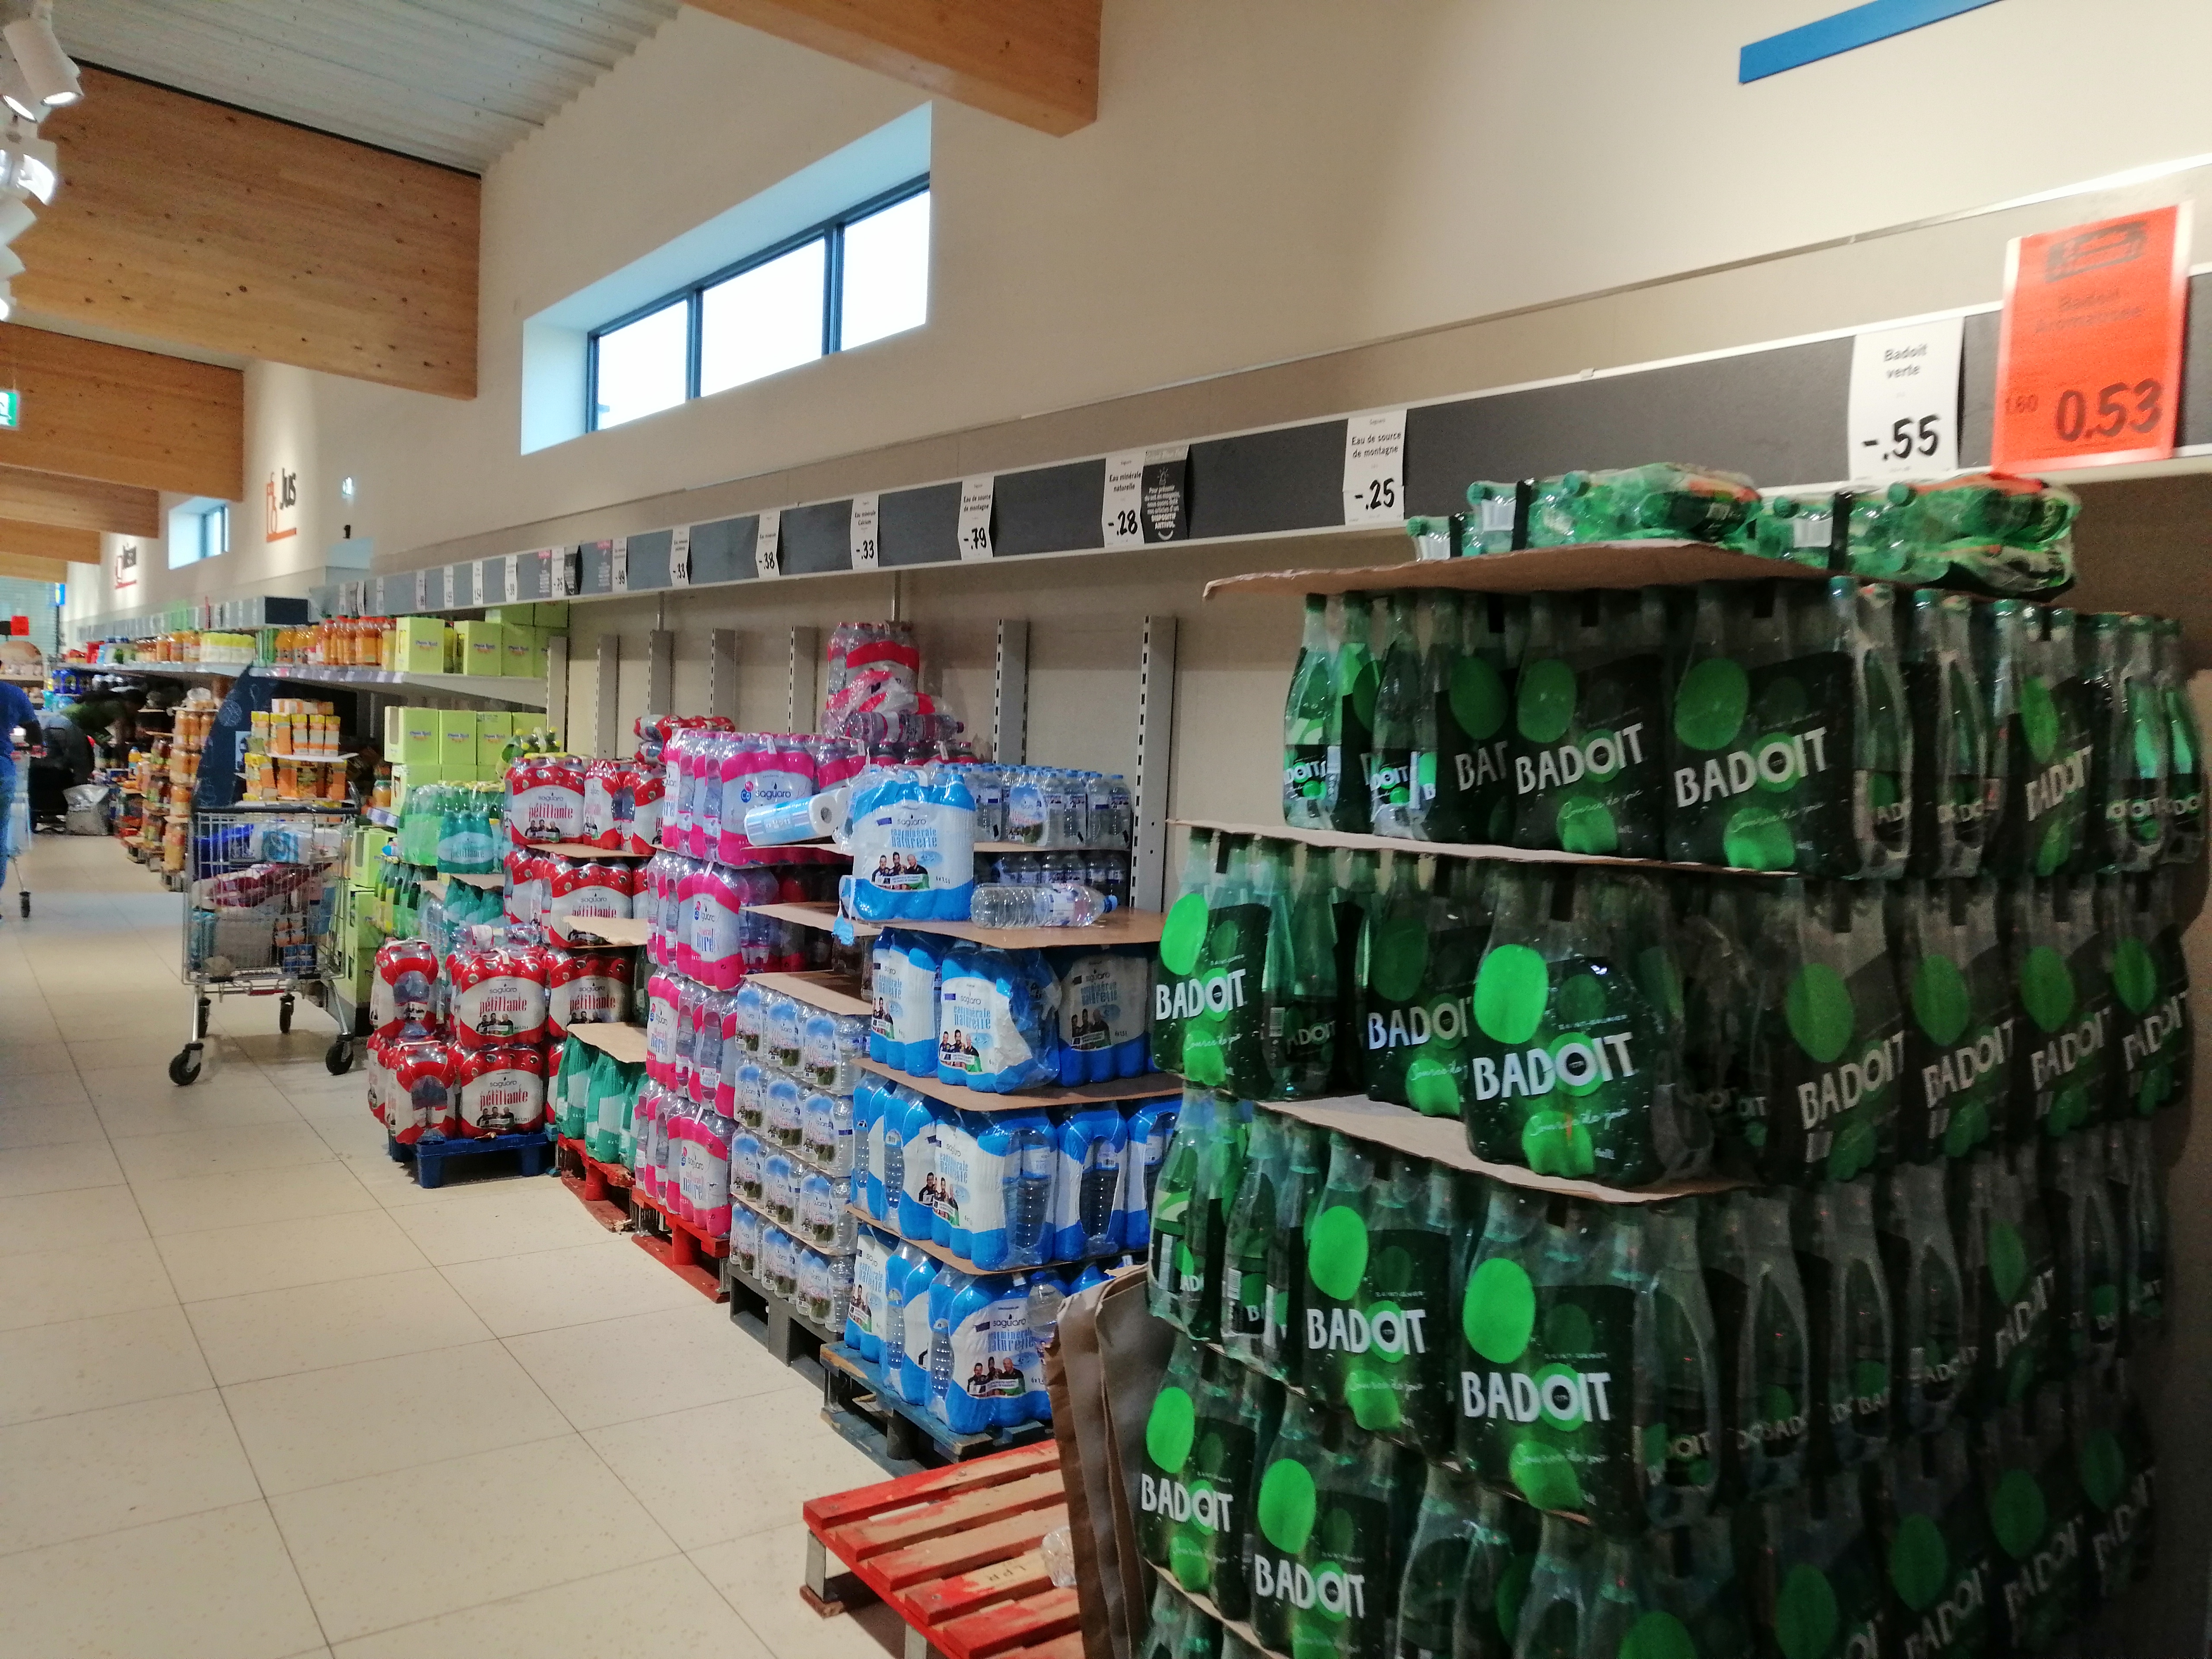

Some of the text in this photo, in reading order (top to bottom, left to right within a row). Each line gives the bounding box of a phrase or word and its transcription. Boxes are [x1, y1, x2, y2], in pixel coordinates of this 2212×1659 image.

[1884, 343, 1927, 362] Badoit
[1887, 365, 1920, 379] verte
[2055, 378, 2163, 442] 0.53
[1351, 432, 1402, 446] Eau de source
[1353, 446, 1398, 458] de montagne
[1109, 471, 1142, 483] Eau minérale
[1113, 483, 1135, 493] naturelle
[280, 467, 296, 511] Jus
[1515, 722, 1644, 795] BADOIT
[1673, 726, 1828, 809] BADOIT
[755, 790, 791, 800] saguaro
[529, 802, 573, 822] pétillante
[891, 830, 938, 849] naturelle
[479, 994, 528, 1017] pétillante
[569, 992, 616, 1014] pétillante
[1155, 969, 1247, 1021] BADOIT
[1472, 1032, 1636, 1101] BADOIT
[489, 1080, 517, 1088] saguaro
[1798, 1030, 1904, 1130] BADOIT
[479, 1087, 528, 1111] pétillante
[993, 1318, 1027, 1328] saguaro
[1306, 1308, 1427, 1355] BADOIT
[1460, 1371, 1611, 1423] BADOIT
[1141, 1473, 1234, 1533] BADOIT
[1254, 1554, 1366, 1619] BADOIT
